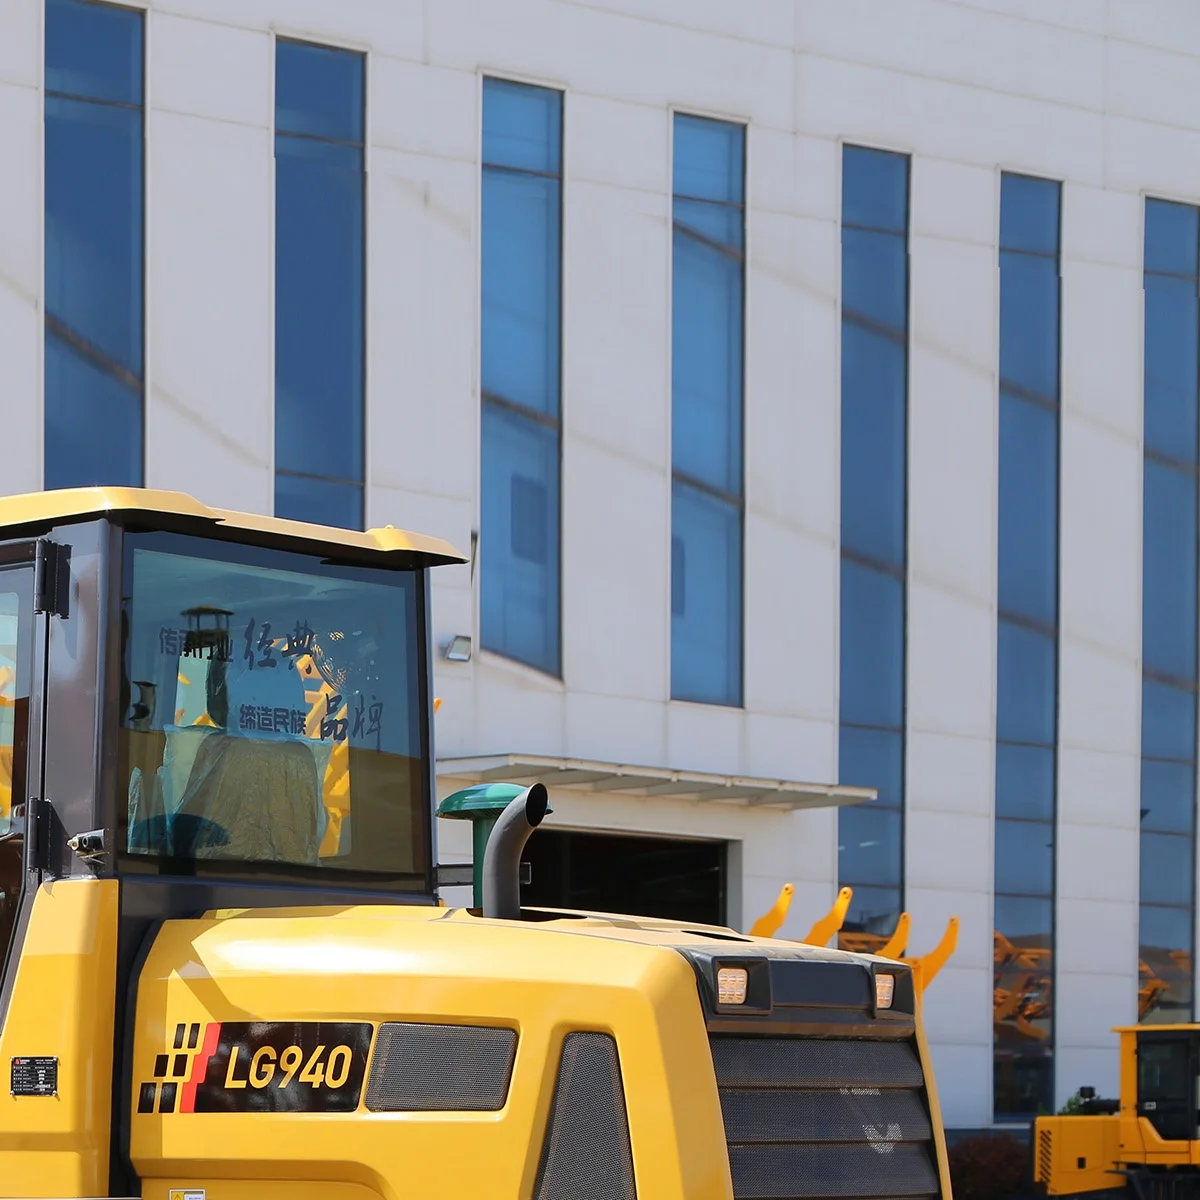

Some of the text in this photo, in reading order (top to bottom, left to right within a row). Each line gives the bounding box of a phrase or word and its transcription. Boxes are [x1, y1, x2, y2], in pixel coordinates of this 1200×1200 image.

[239, 693, 384, 752] 缔造民族 品牌
[224, 1045, 353, 1089] LG940
